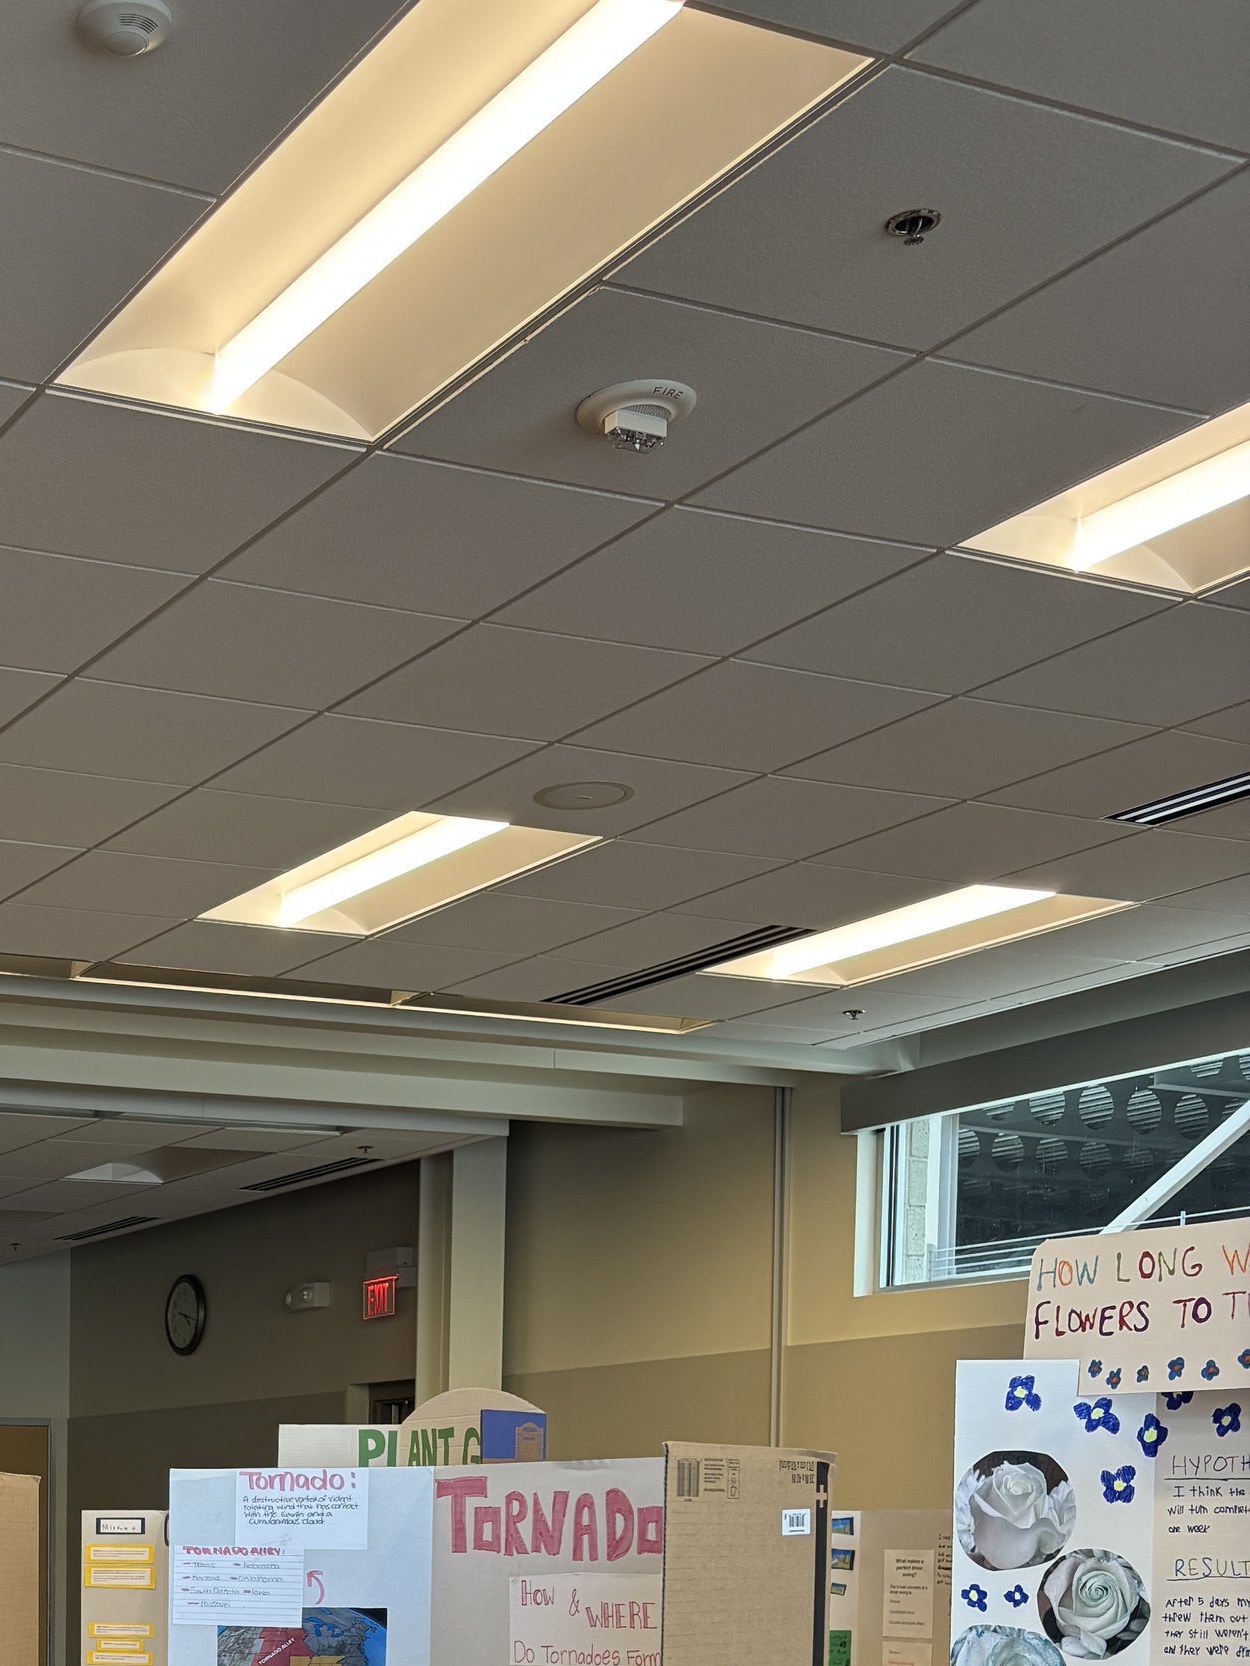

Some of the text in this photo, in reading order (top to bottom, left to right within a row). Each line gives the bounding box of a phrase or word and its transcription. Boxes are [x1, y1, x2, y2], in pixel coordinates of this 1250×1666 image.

[653, 387, 683, 399] FIRE
[1037, 1256, 1099, 1291] HOW
[1117, 1246, 1203, 1282] LONG
[367, 1282, 389, 1316] EXIT
[1034, 1297, 1212, 1339] FLOWERS TO
[1173, 1486, 1185, 1497] I
[1190, 1486, 1222, 1497] think
[1187, 1524, 1210, 1533] week
[1198, 1597, 1204, 1605] 5
[569, 1589, 579, 1616] &
[586, 1601, 658, 1629] WHERE
[1200, 1612, 1225, 1623] them
[514, 1641, 660, 1666] Do Tornadoes Form
[1180, 1644, 1200, 1655] they
